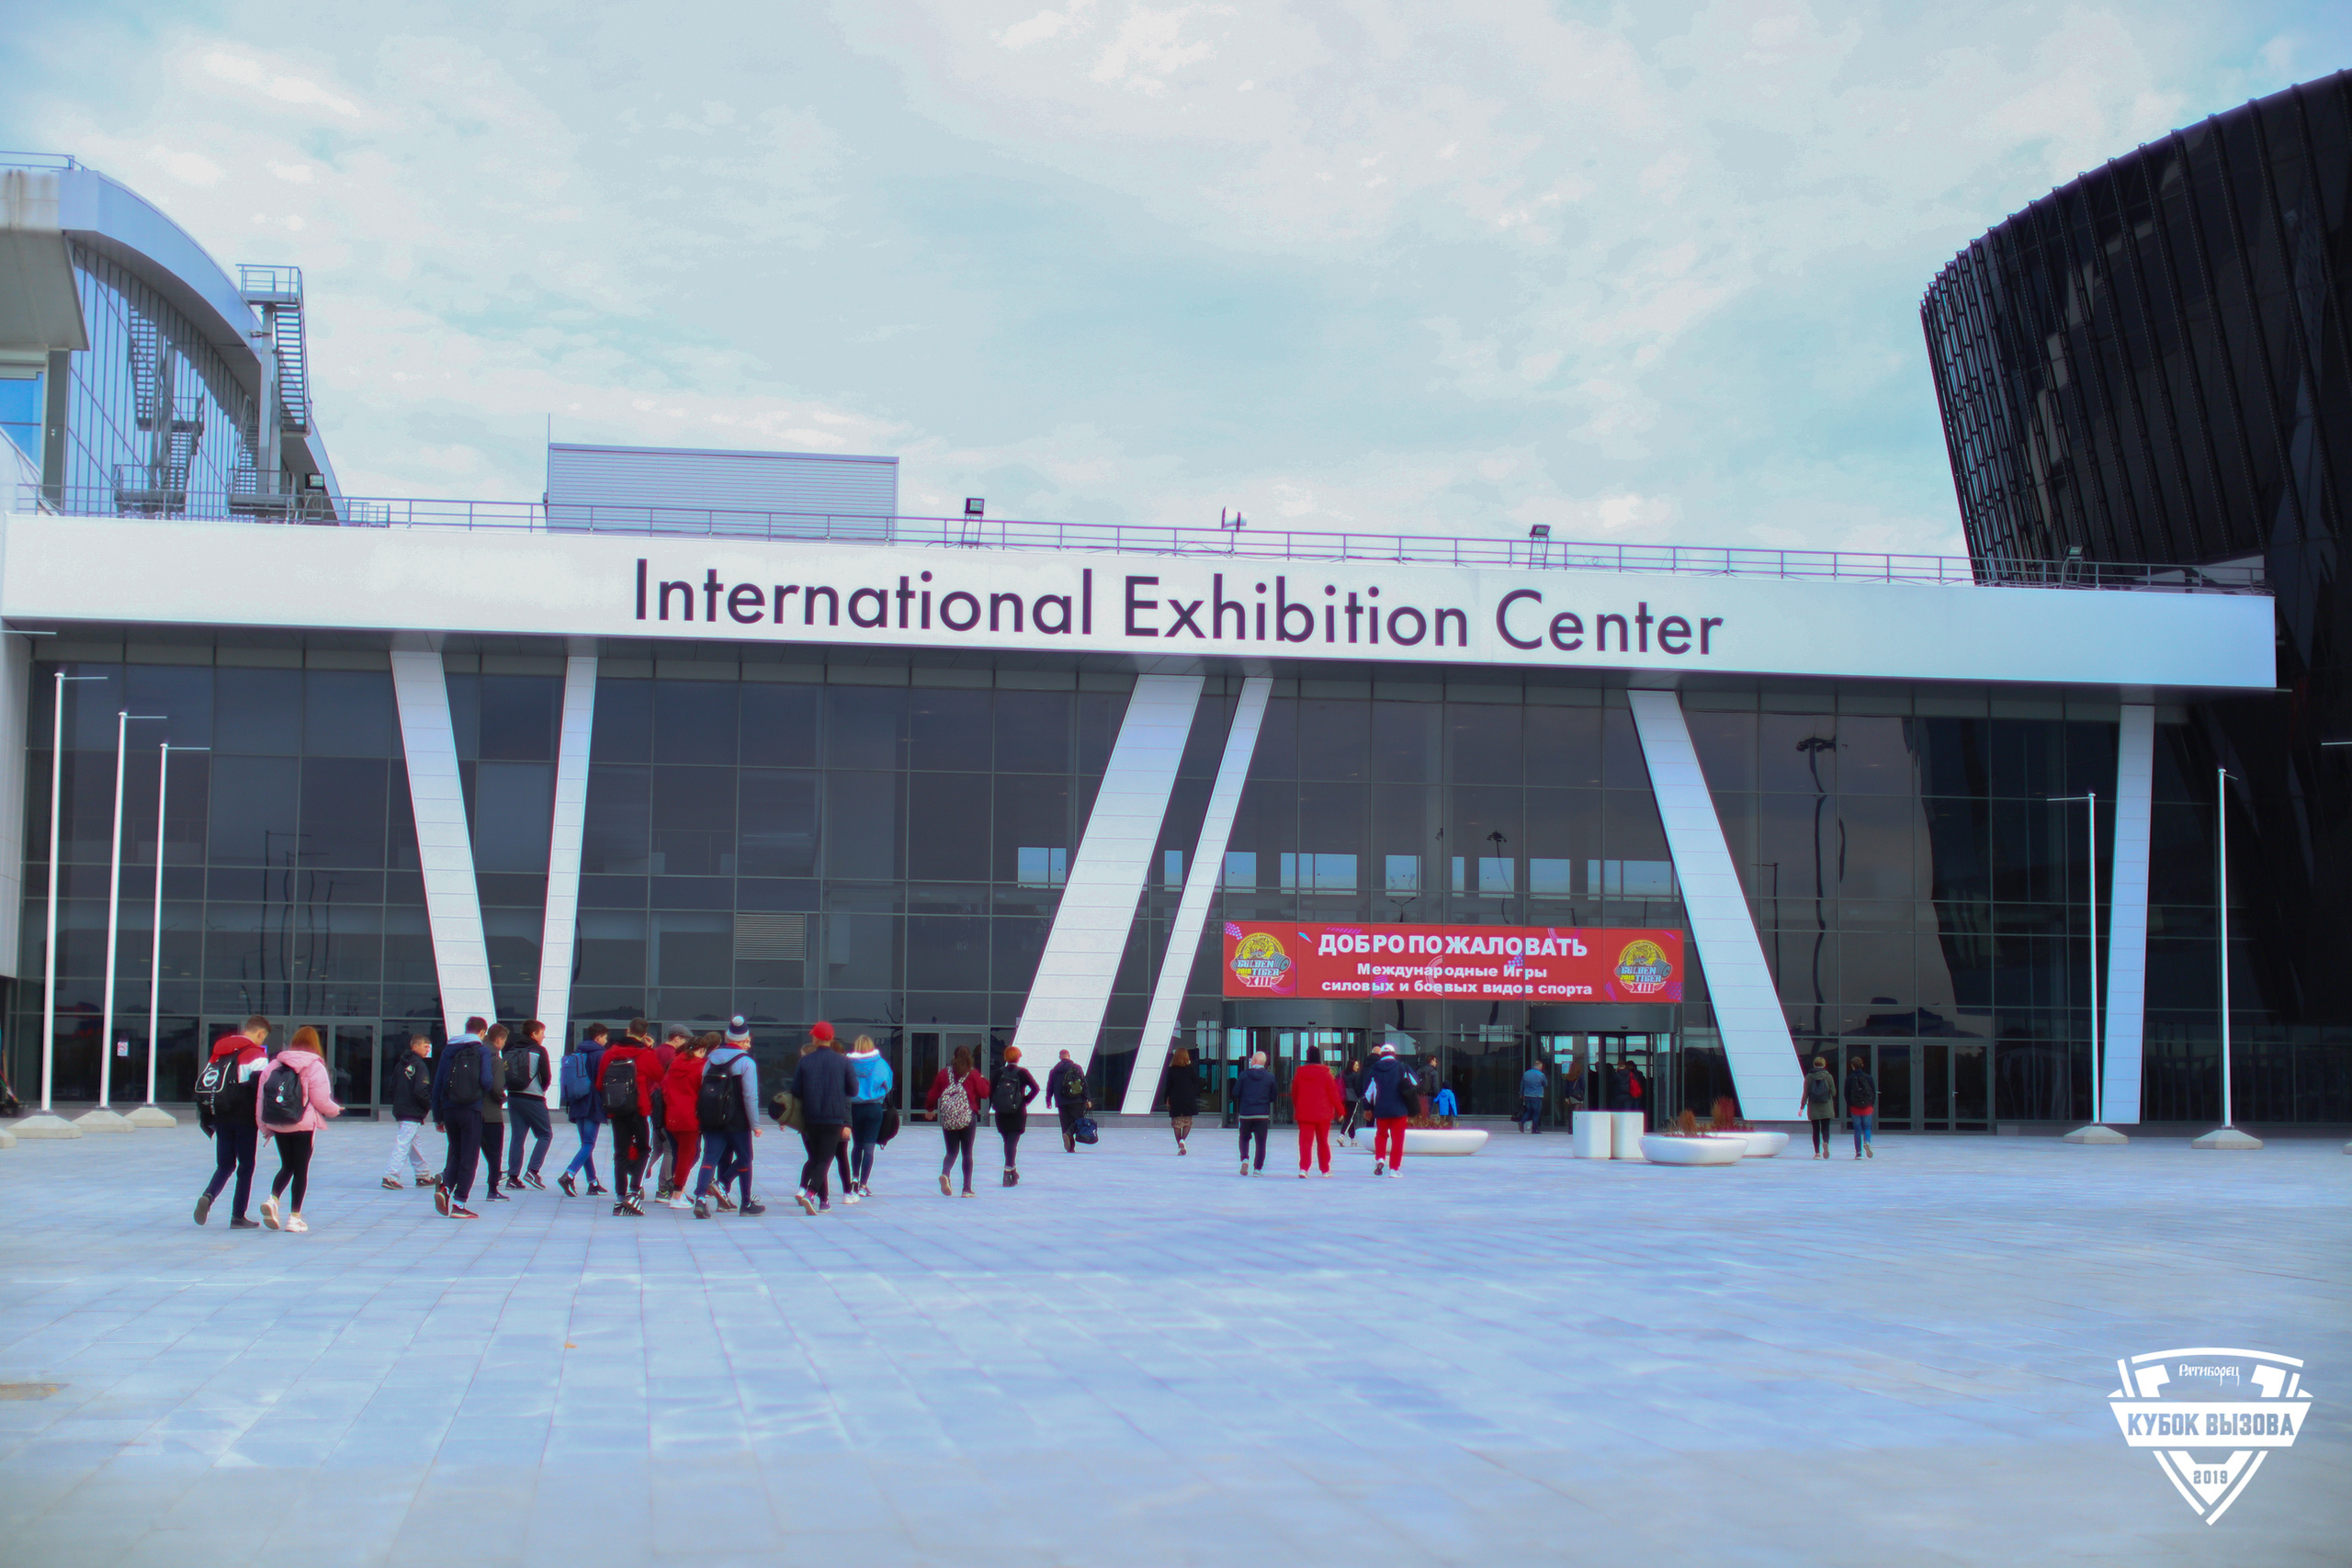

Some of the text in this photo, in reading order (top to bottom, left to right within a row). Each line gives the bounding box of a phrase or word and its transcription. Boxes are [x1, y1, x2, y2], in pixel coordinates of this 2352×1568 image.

[636, 558, 1724, 656] International Exhibition Center
[1318, 933, 1588, 956] ДОБРО ПОЖАЛОВАТЬ
[1252, 968, 1280, 976] TIGER
[1357, 963, 1547, 980] Международные Игры
[1321, 980, 1592, 997] силовых и боевых видов спорта
